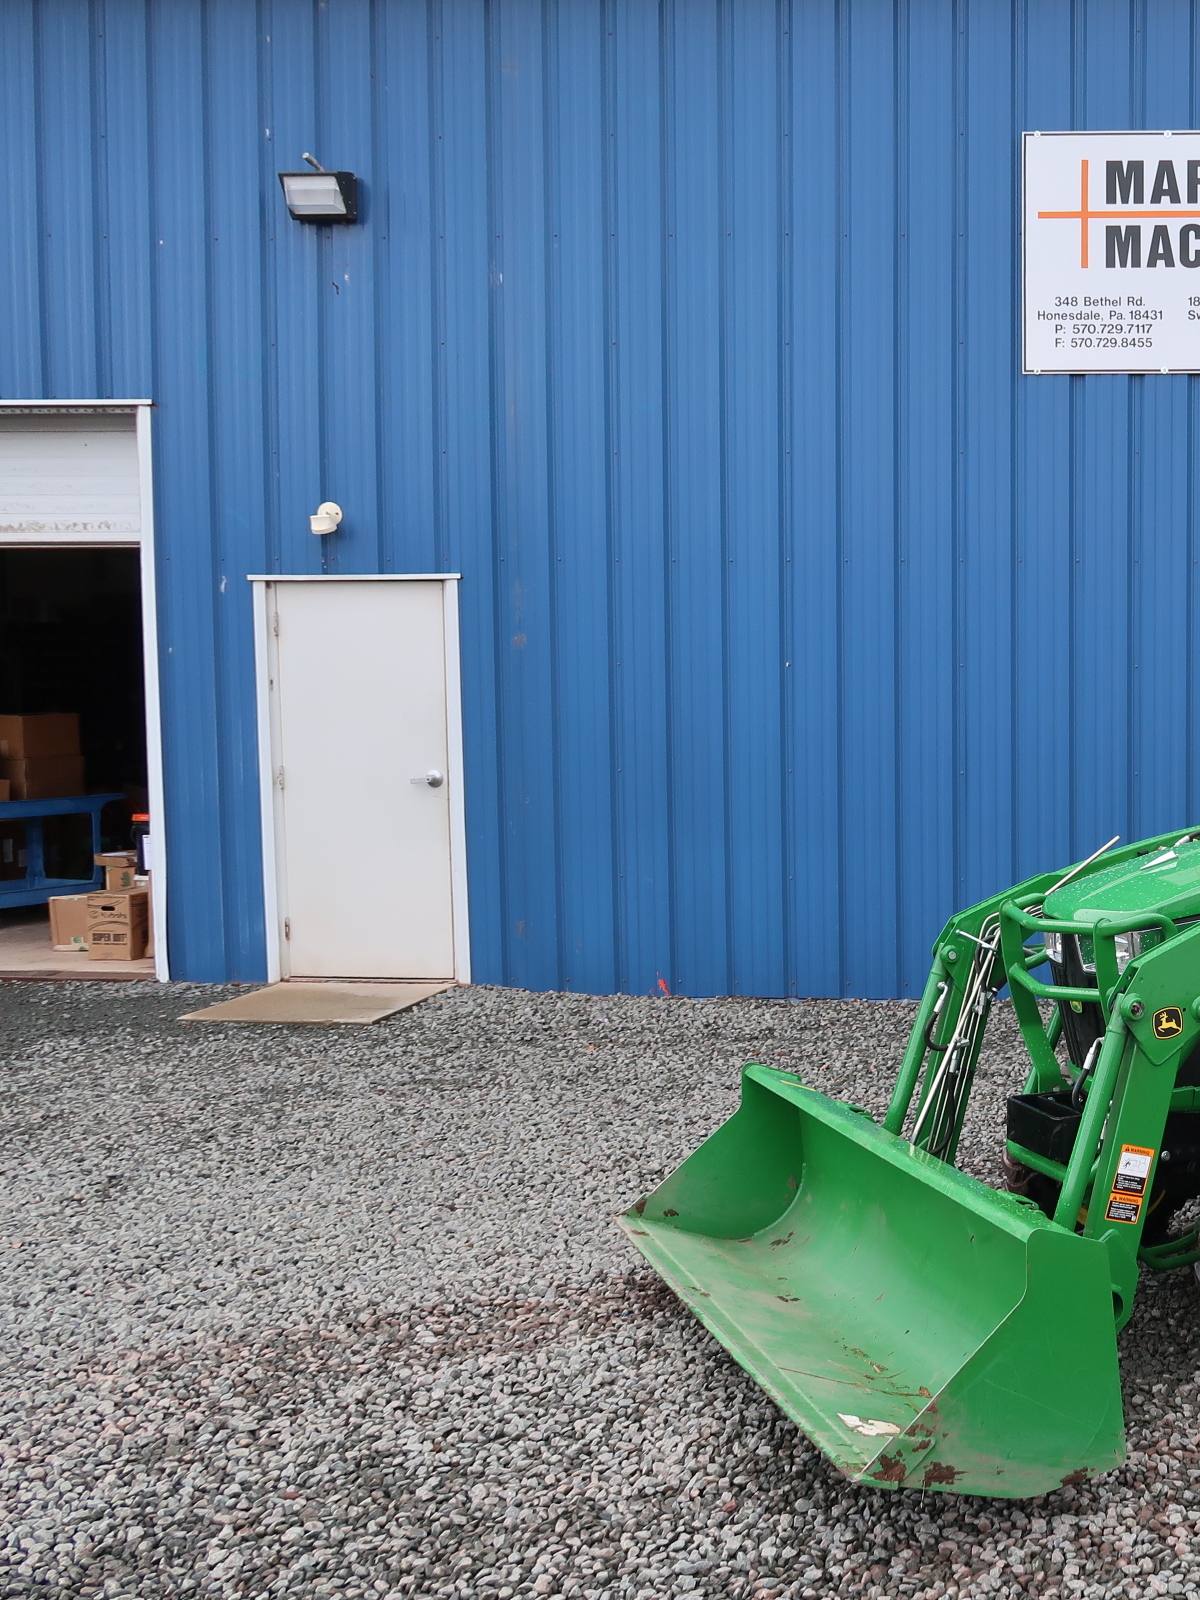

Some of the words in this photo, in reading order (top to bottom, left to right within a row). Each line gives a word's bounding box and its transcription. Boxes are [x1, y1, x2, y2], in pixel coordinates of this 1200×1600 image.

[1054, 296, 1079, 307] 348
[1083, 296, 1122, 307] Bethel
[1127, 296, 1146, 307] Rd.
[1037, 310, 1104, 322] Honesdale,
[1109, 310, 1126, 321] Pa.
[1128, 309, 1163, 321] 18431
[1054, 323, 1066, 335] P:
[1072, 323, 1153, 335] 570.729.7117
[1055, 337, 1065, 348] F:
[1070, 337, 1153, 348] 570.729.8455
[1130, 1147, 1150, 1156] WARNING
